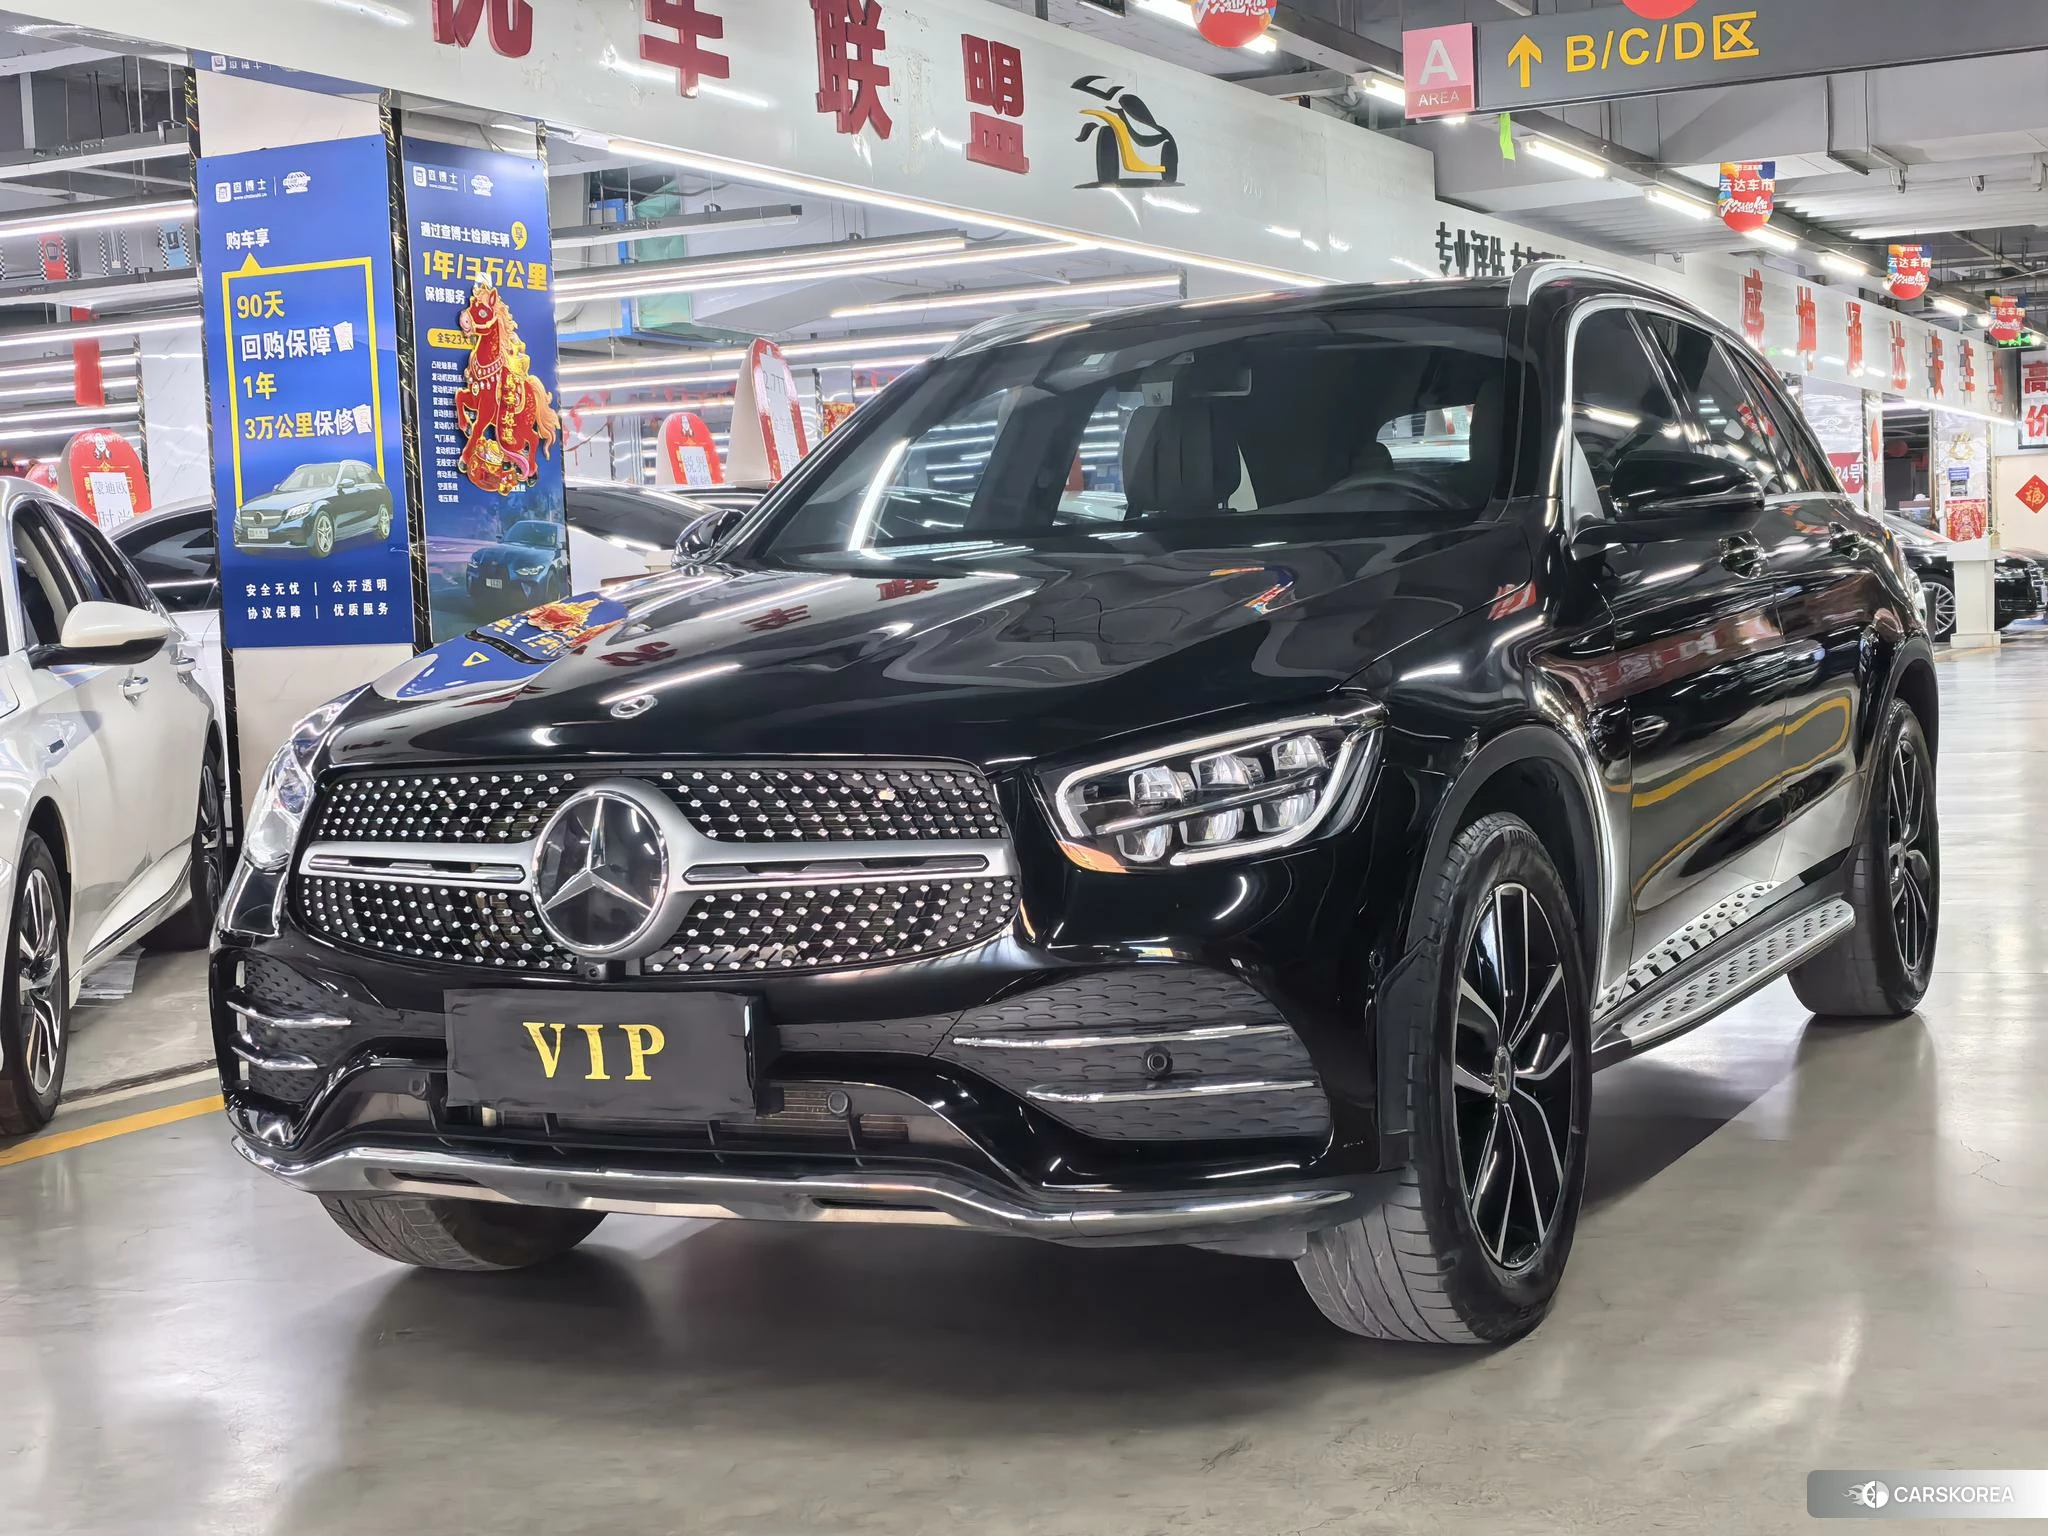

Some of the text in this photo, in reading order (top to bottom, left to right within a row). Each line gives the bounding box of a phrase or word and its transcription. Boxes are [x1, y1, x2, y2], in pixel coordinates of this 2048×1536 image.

[1566, 10, 1760, 74] B/C/D区
[1418, 38, 1458, 86] A
[1418, 90, 1460, 107] AREA
[1720, 178, 1775, 193] 云达车市
[225, 227, 270, 250] 购车享
[420, 221, 510, 249] 通过查博士检测车辆
[422, 250, 548, 291] 1年/3万公里
[1888, 257, 1932, 269] 云达车市
[236, 290, 285, 319] 90天
[425, 285, 466, 305] 保修服务
[241, 326, 331, 362] 回购保障
[243, 371, 278, 400] 1年
[244, 408, 355, 441] 3万公里保修
[2025, 481, 2046, 505] 福
[246, 578, 388, 597] 安全无忧 公开透明
[247, 602, 389, 620] 协议保障 优质服务
[522, 1021, 666, 1081] VIP
